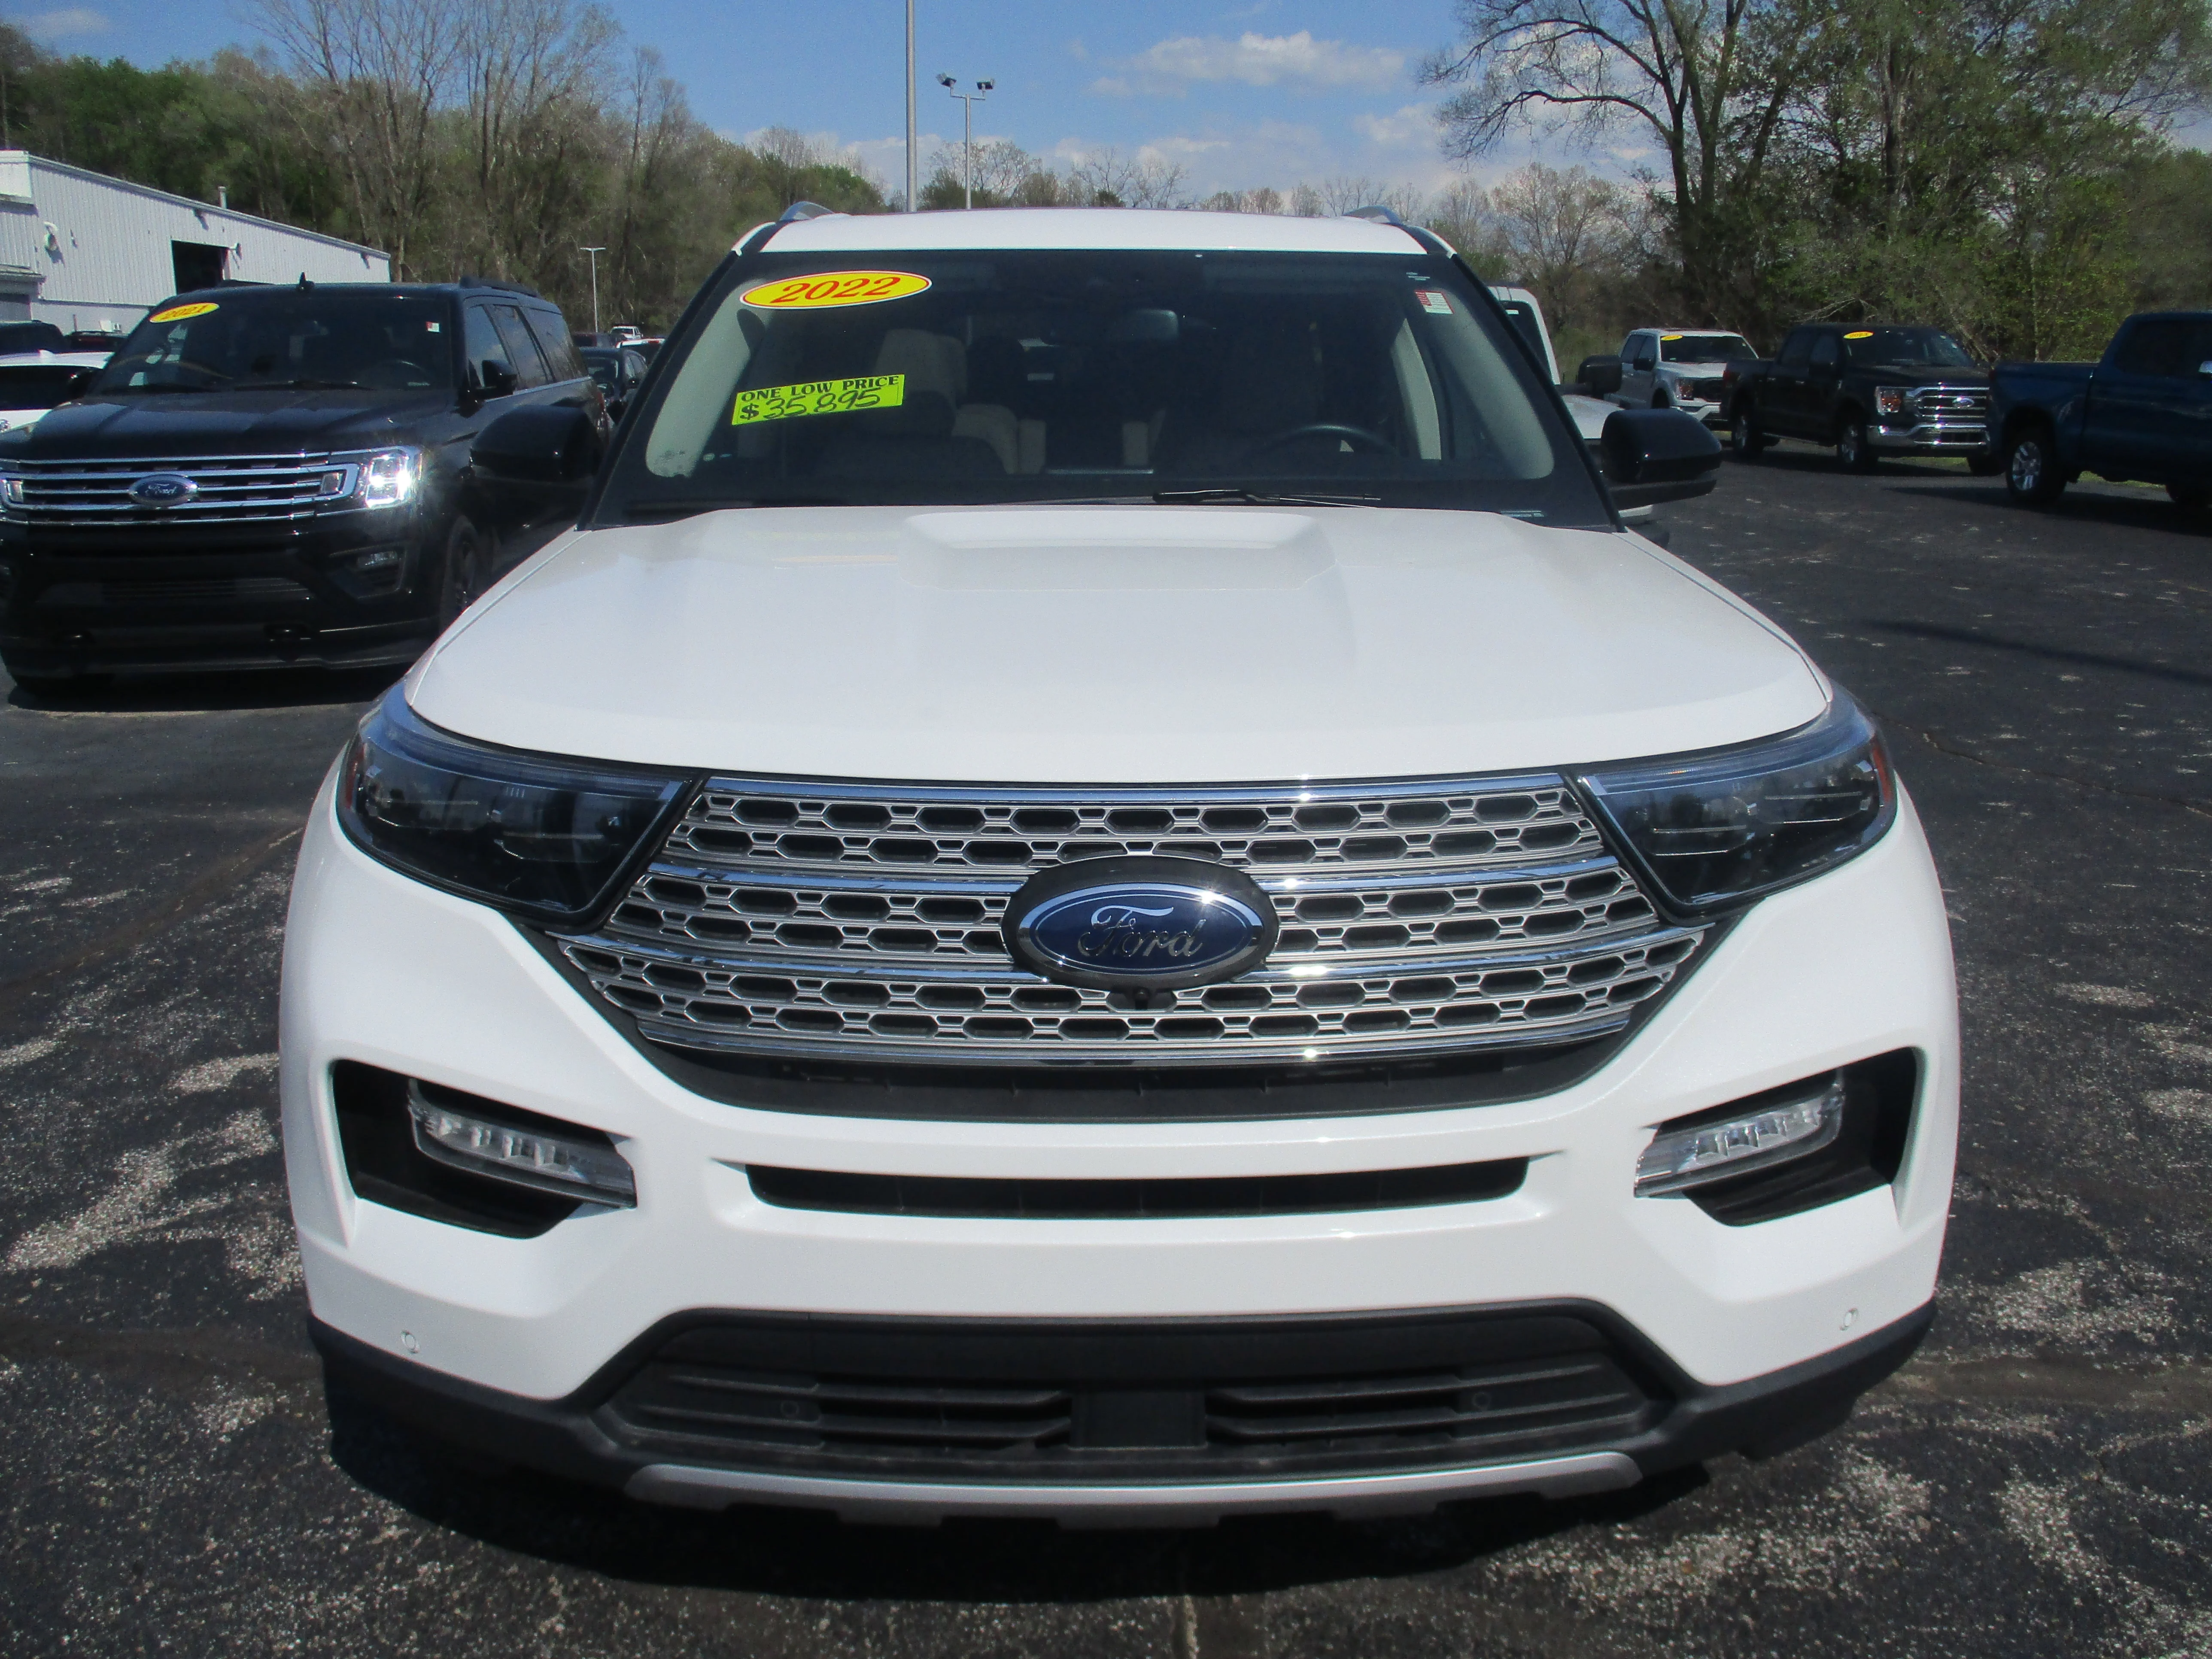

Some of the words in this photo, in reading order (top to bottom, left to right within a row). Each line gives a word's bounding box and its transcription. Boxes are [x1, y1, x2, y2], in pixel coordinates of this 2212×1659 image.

[769, 277, 901, 304] 2022
[741, 387, 781, 402] ONE
[791, 381, 833, 395] LOW
[842, 376, 899, 392] PRICE
[1078, 905, 1206, 957] Ford
